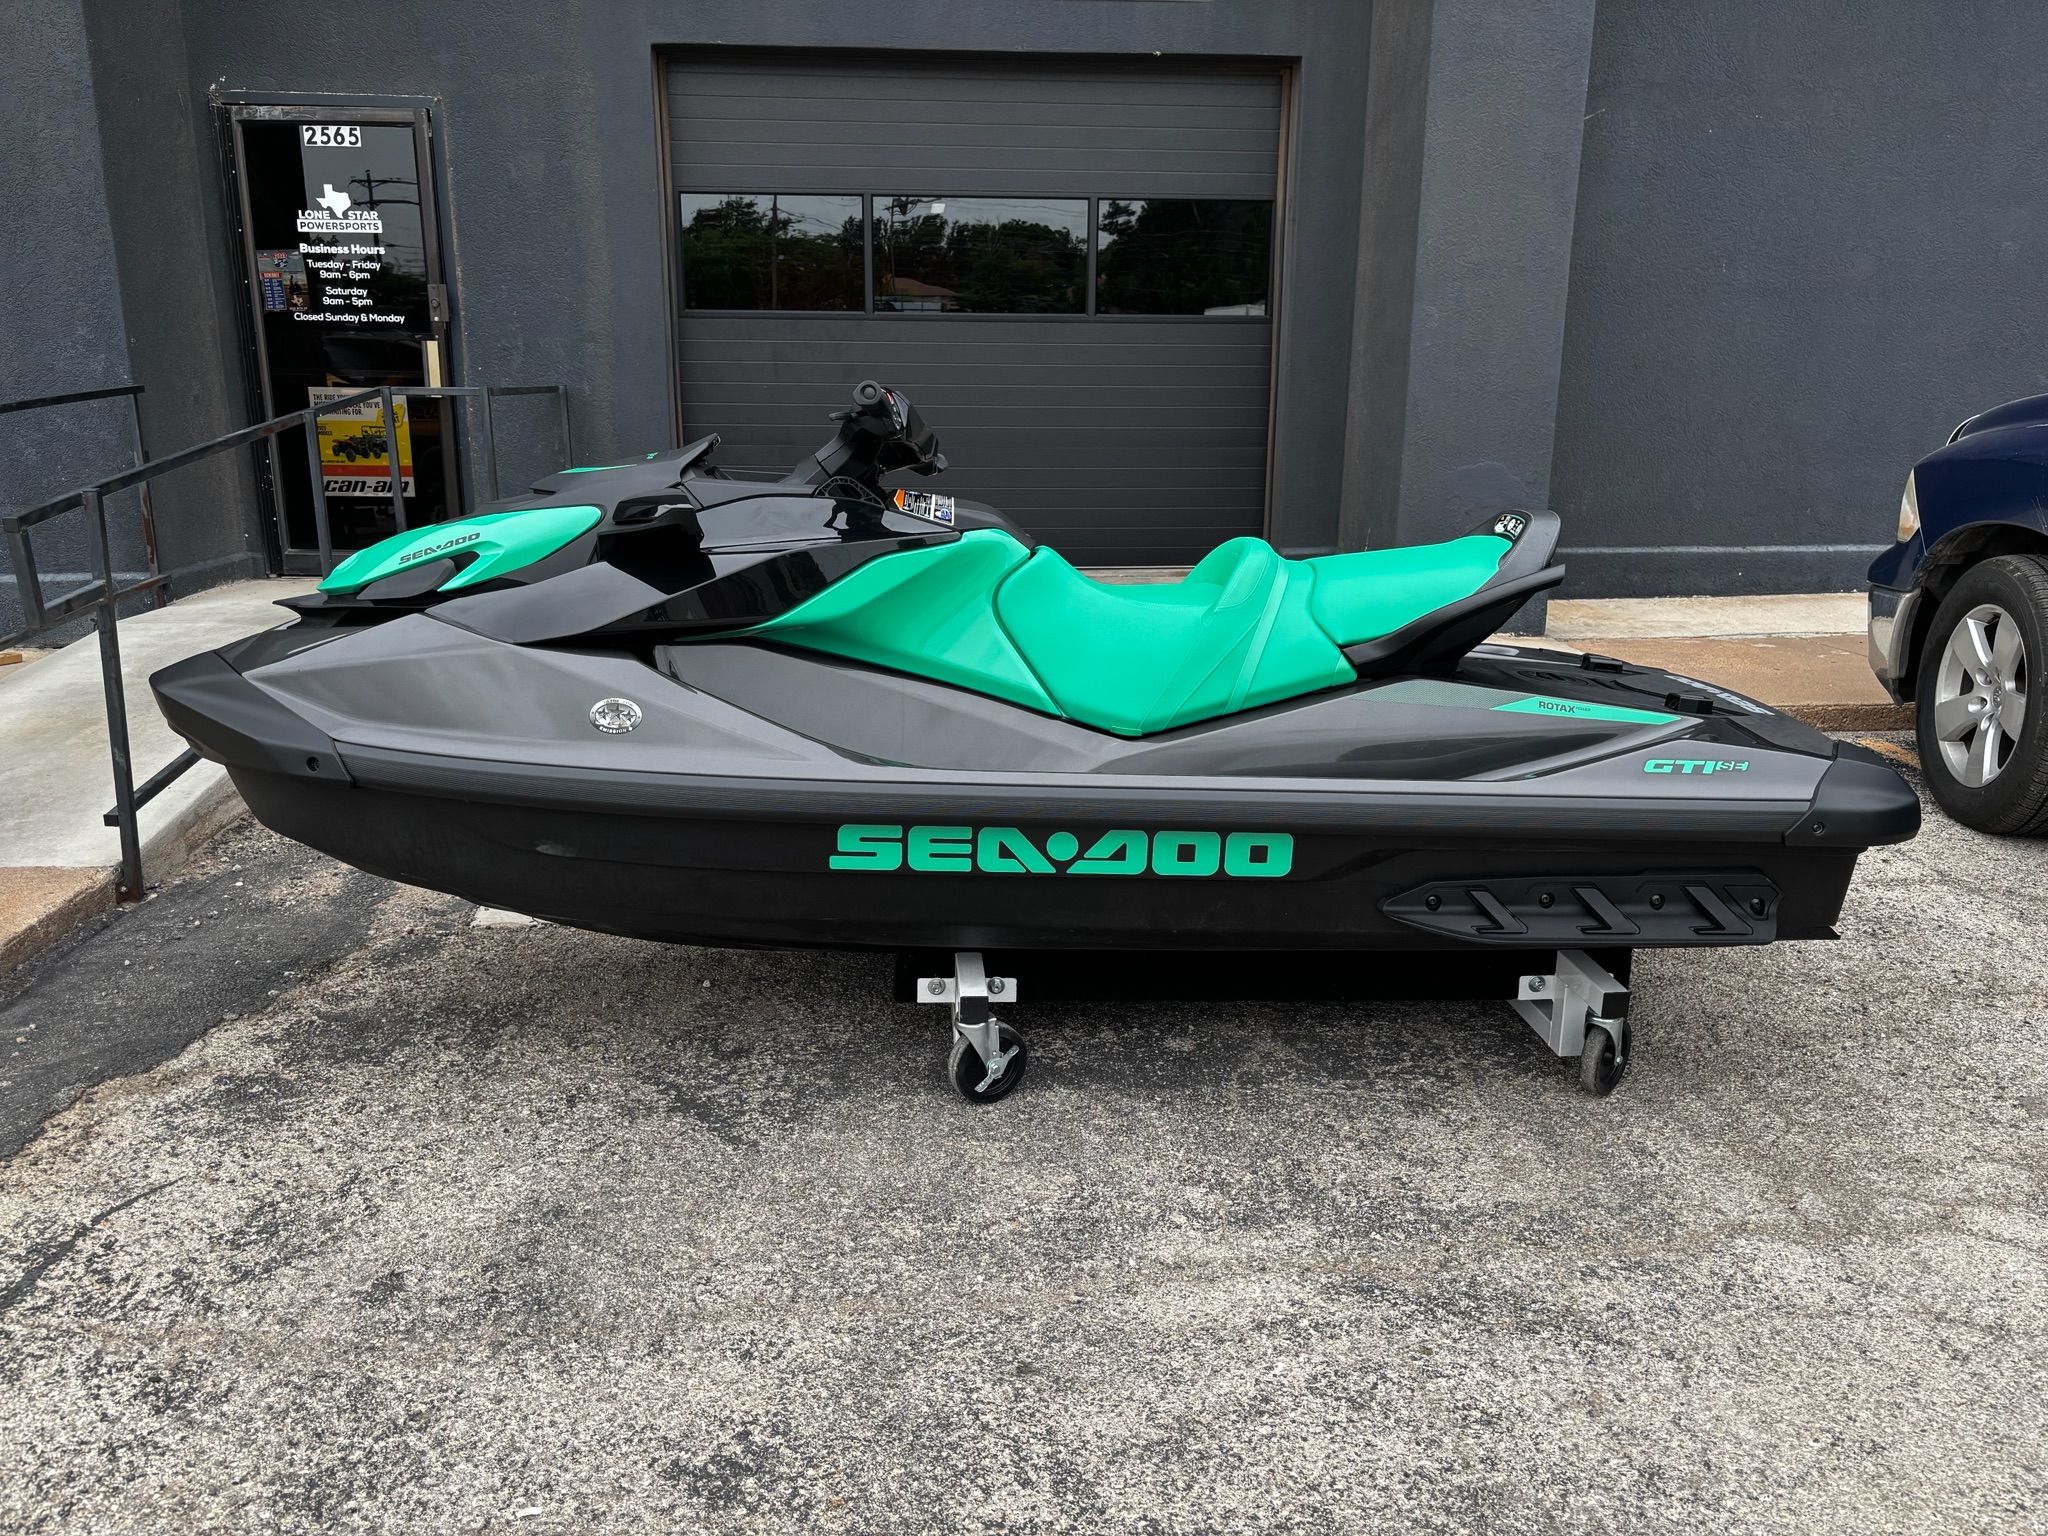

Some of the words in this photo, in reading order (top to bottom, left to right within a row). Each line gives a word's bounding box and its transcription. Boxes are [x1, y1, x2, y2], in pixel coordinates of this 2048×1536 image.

[304, 126, 359, 146] 2565
[298, 209, 331, 219] LONE
[347, 210, 379, 220] STAR
[299, 221, 380, 231] POWERSPORTS
[299, 243, 350, 254] Business
[351, 244, 386, 255] Hours
[306, 259, 345, 270] Tuesday
[352, 260, 381, 271] Friday
[319, 270, 341, 279] 9am
[348, 270, 371, 281] 6pm
[325, 286, 368, 297] Saturday
[322, 296, 344, 306] 9am
[351, 297, 373, 307] 5pm
[293, 312, 324, 321] Closed
[325, 313, 360, 324] Sunday
[360, 313, 368, 322] &
[369, 313, 405, 324] Monday
[1538, 701, 1576, 714] ROTAX
[1643, 759, 1716, 775] GTI
